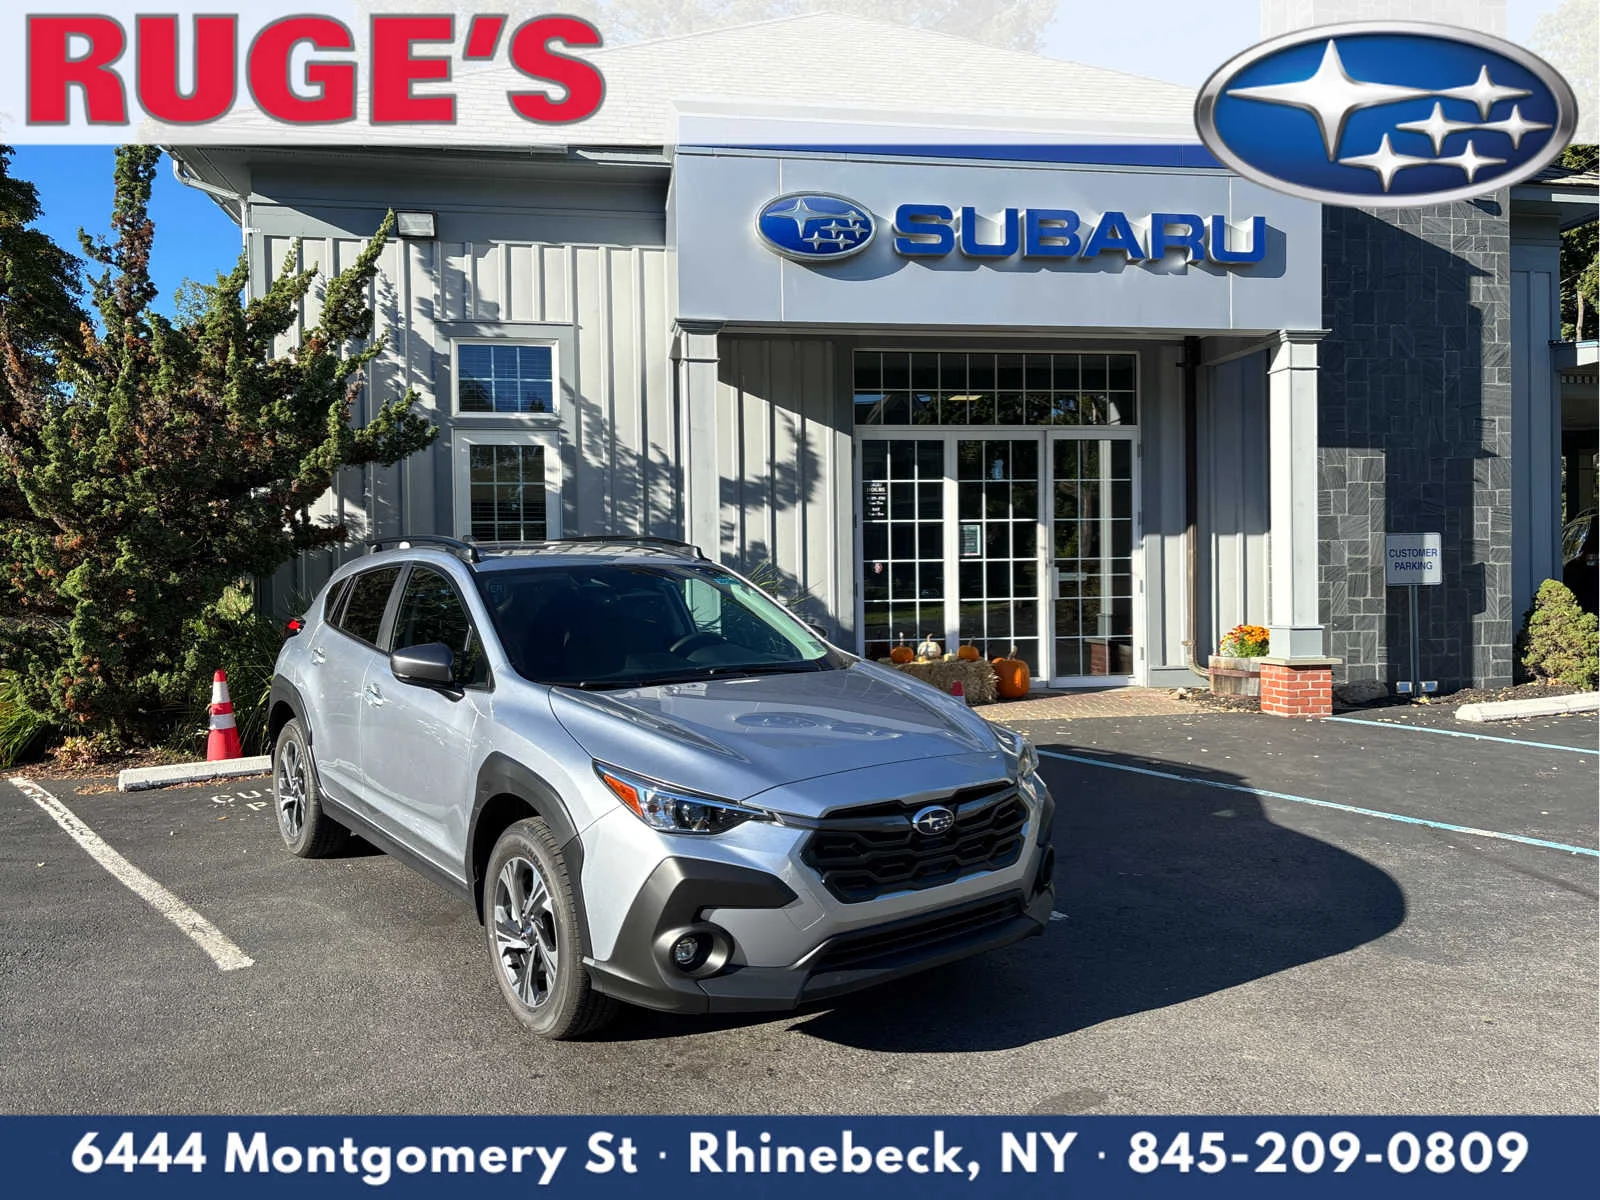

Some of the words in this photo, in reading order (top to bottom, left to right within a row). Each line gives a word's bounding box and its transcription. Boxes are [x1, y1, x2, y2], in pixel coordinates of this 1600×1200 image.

[893, 203, 1267, 266] SUBARU
[1388, 548, 1438, 558] CUSTOMER
[1394, 561, 1433, 570] PARKING
